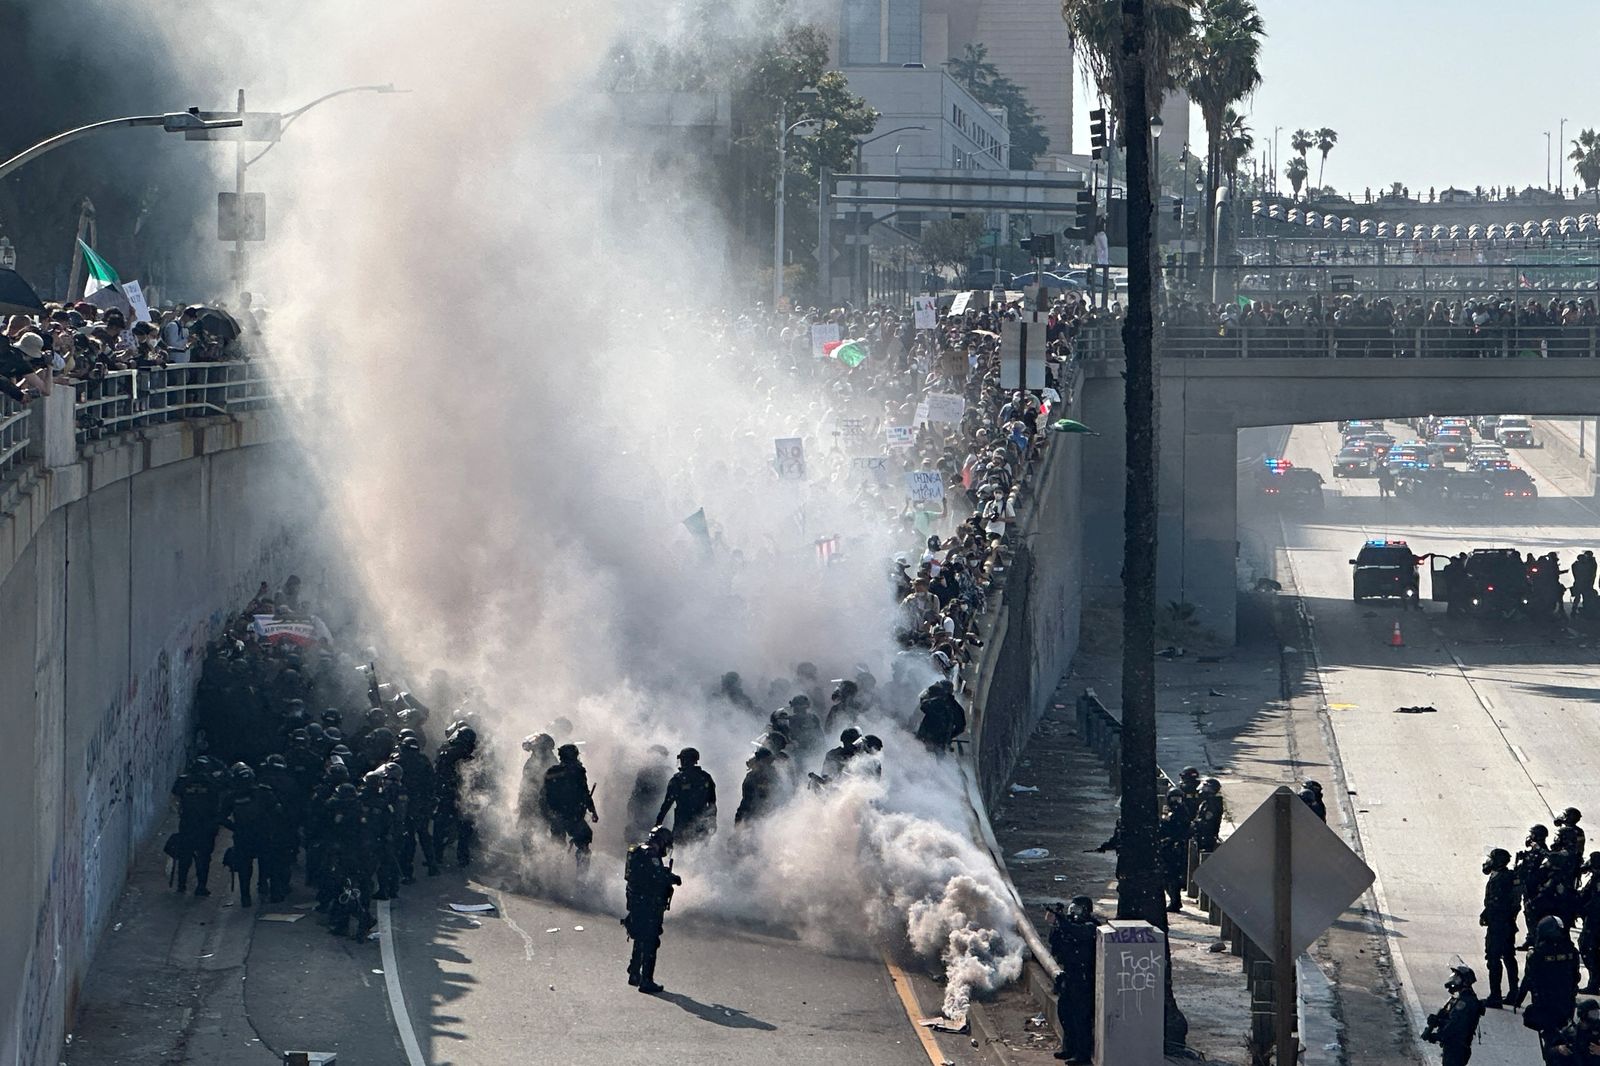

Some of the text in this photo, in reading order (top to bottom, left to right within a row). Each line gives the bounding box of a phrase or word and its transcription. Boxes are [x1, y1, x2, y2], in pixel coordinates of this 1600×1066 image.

[776, 446, 801, 458] NO
[919, 483, 929, 491] LA
[1116, 972, 1156, 993] ICE
